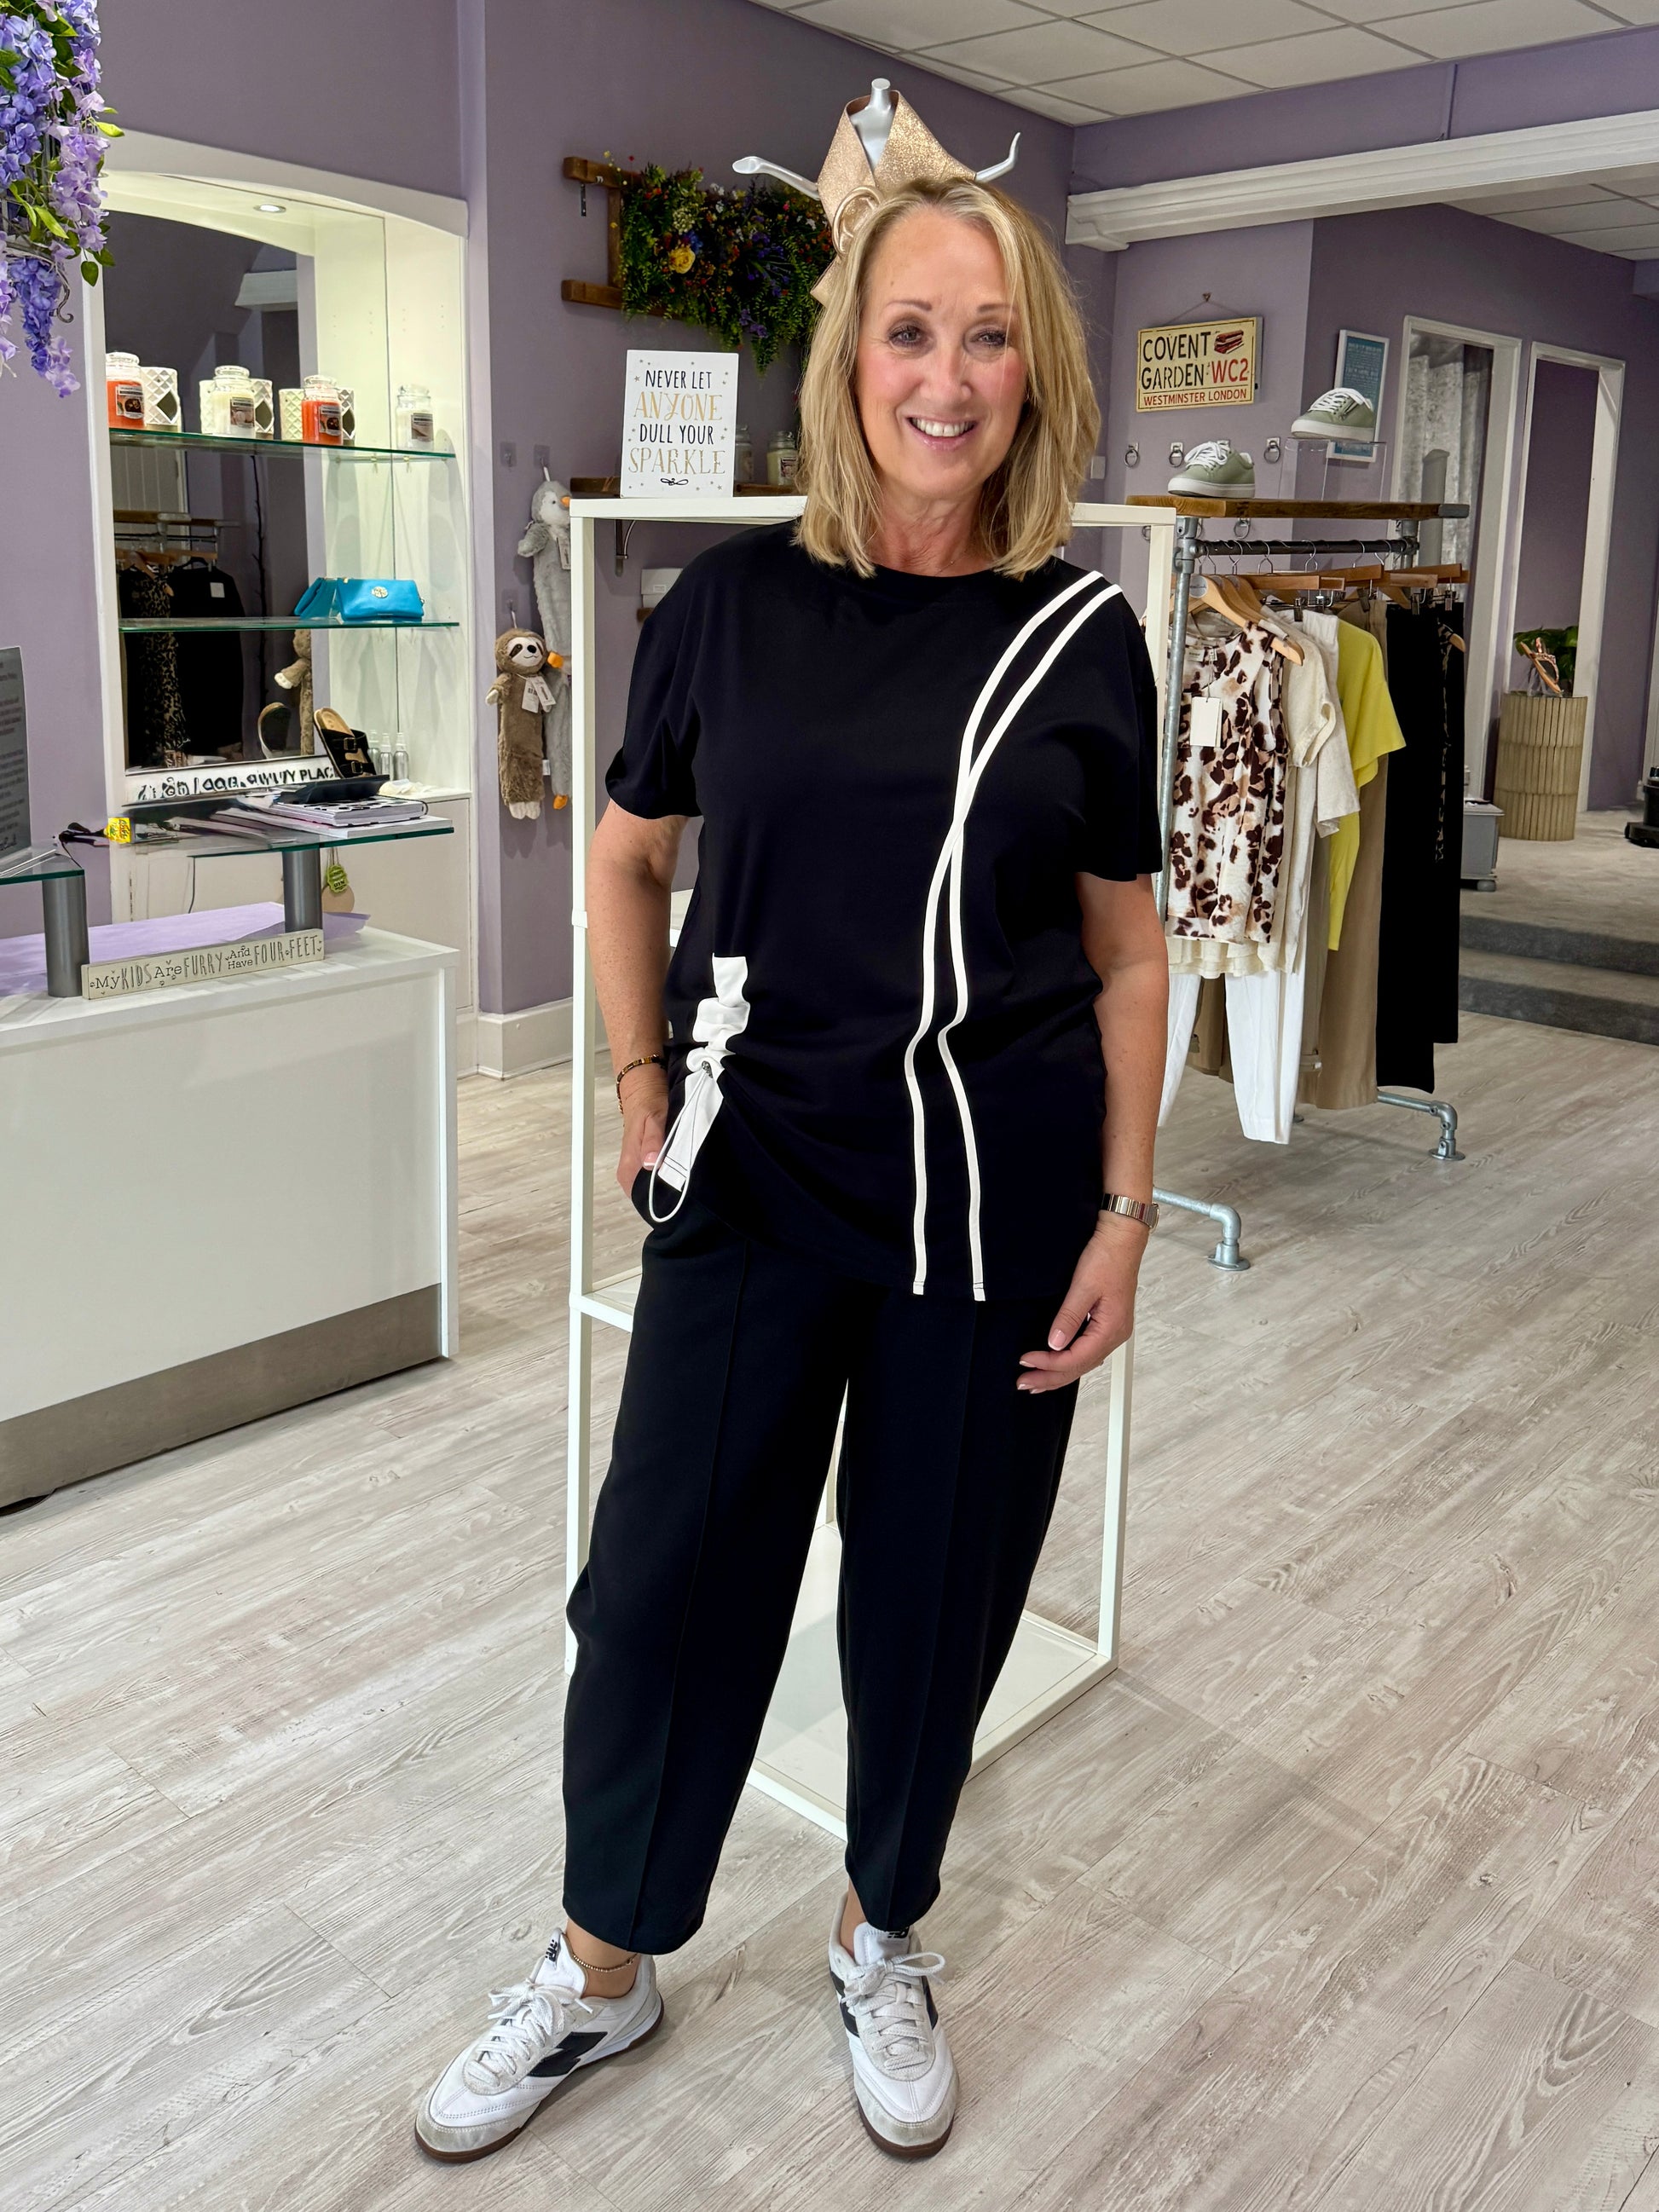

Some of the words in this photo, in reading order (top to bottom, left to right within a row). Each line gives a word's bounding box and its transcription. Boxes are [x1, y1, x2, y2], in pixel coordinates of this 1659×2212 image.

[1143, 332, 1211, 362] COVENT
[645, 370, 686, 389] NEVER
[691, 372, 712, 389] LET
[1142, 363, 1204, 390] GARDEN
[1211, 358, 1248, 384] WC2
[633, 391, 722, 421] ANYONE
[1144, 392, 1205, 406] WESTMINSTER
[1208, 389, 1246, 401] LONDON
[639, 424, 673, 443] DULL
[679, 425, 714, 444] YOUR
[628, 448, 725, 475] SPARKLE
[299, 767, 333, 781] PLAC
[229, 948, 251, 959] And
[254, 941, 285, 966] FOUR
[289, 934, 318, 959] FEET
[154, 965, 182, 979] Are
[183, 951, 223, 978] FURRY
[228, 959, 253, 970] Have
[95, 975, 120, 990] My
[121, 963, 153, 990] KIDS
